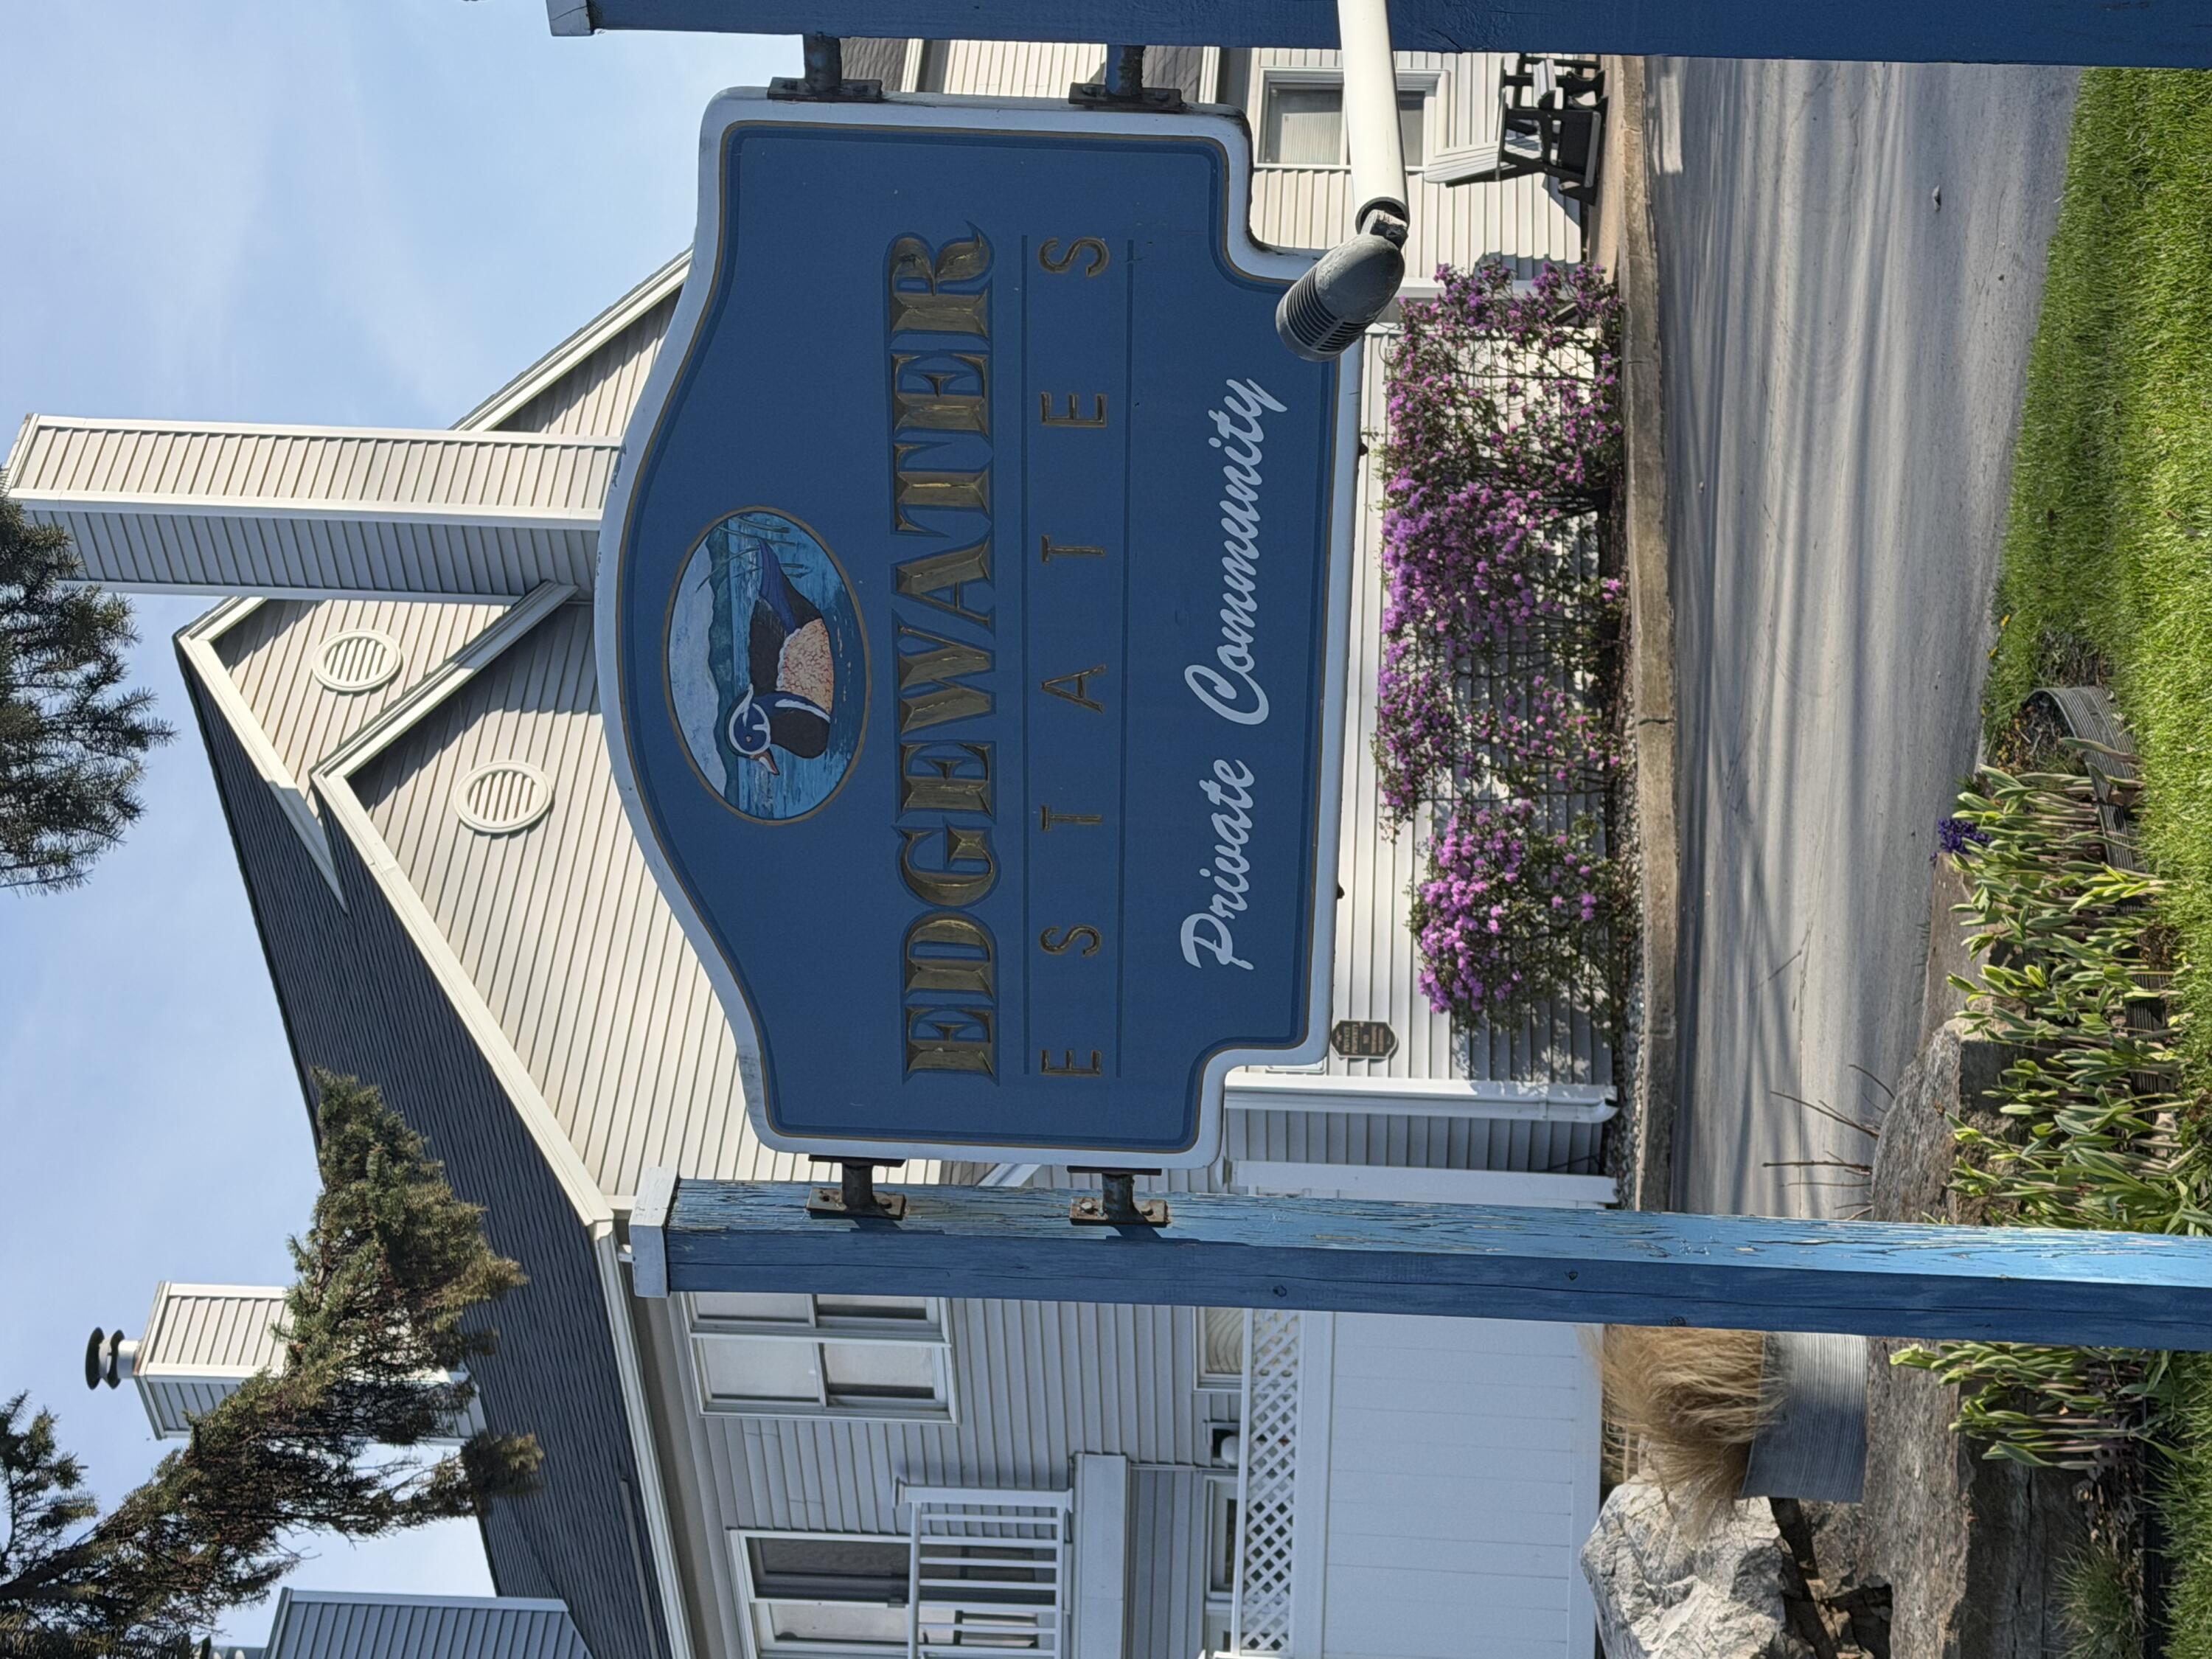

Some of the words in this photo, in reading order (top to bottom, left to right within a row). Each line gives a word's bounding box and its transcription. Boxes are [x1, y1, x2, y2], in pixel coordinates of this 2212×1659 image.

[887, 220, 998, 1082] EDGEWATER
[1038, 236, 1110, 1077] ESTATES
[1183, 377, 1288, 726] Community
[1180, 759, 1255, 970] Private
